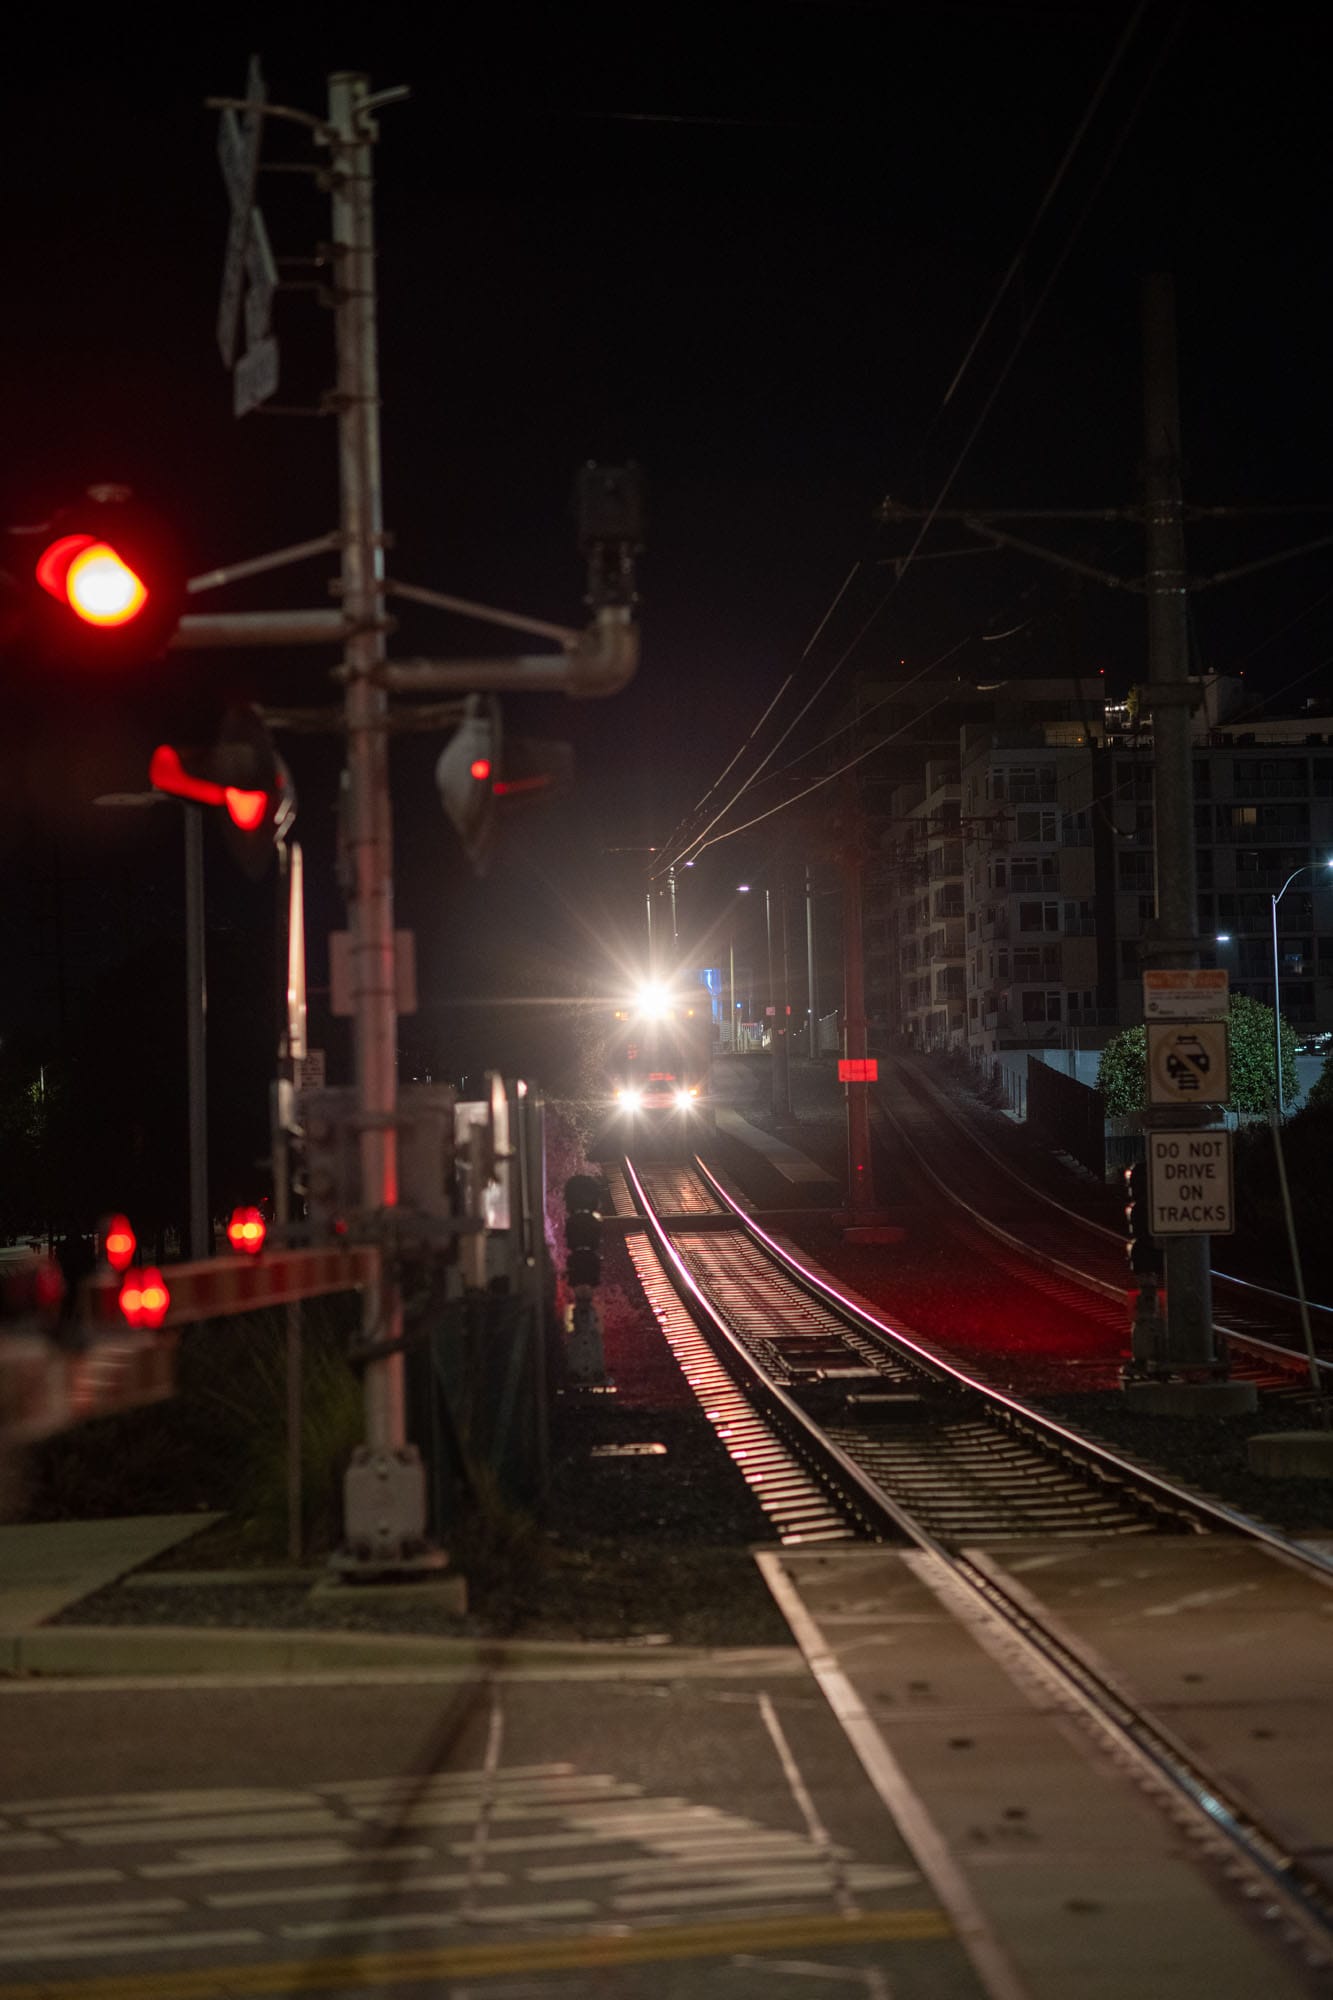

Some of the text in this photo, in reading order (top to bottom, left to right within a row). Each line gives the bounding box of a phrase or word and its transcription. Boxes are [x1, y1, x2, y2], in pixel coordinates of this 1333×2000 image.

[1157, 1142, 1223, 1158] DO NOT
[1165, 1164, 1215, 1179] DRIVE
[1180, 1185, 1202, 1200] ON
[1158, 1206, 1225, 1221] TRACKS
